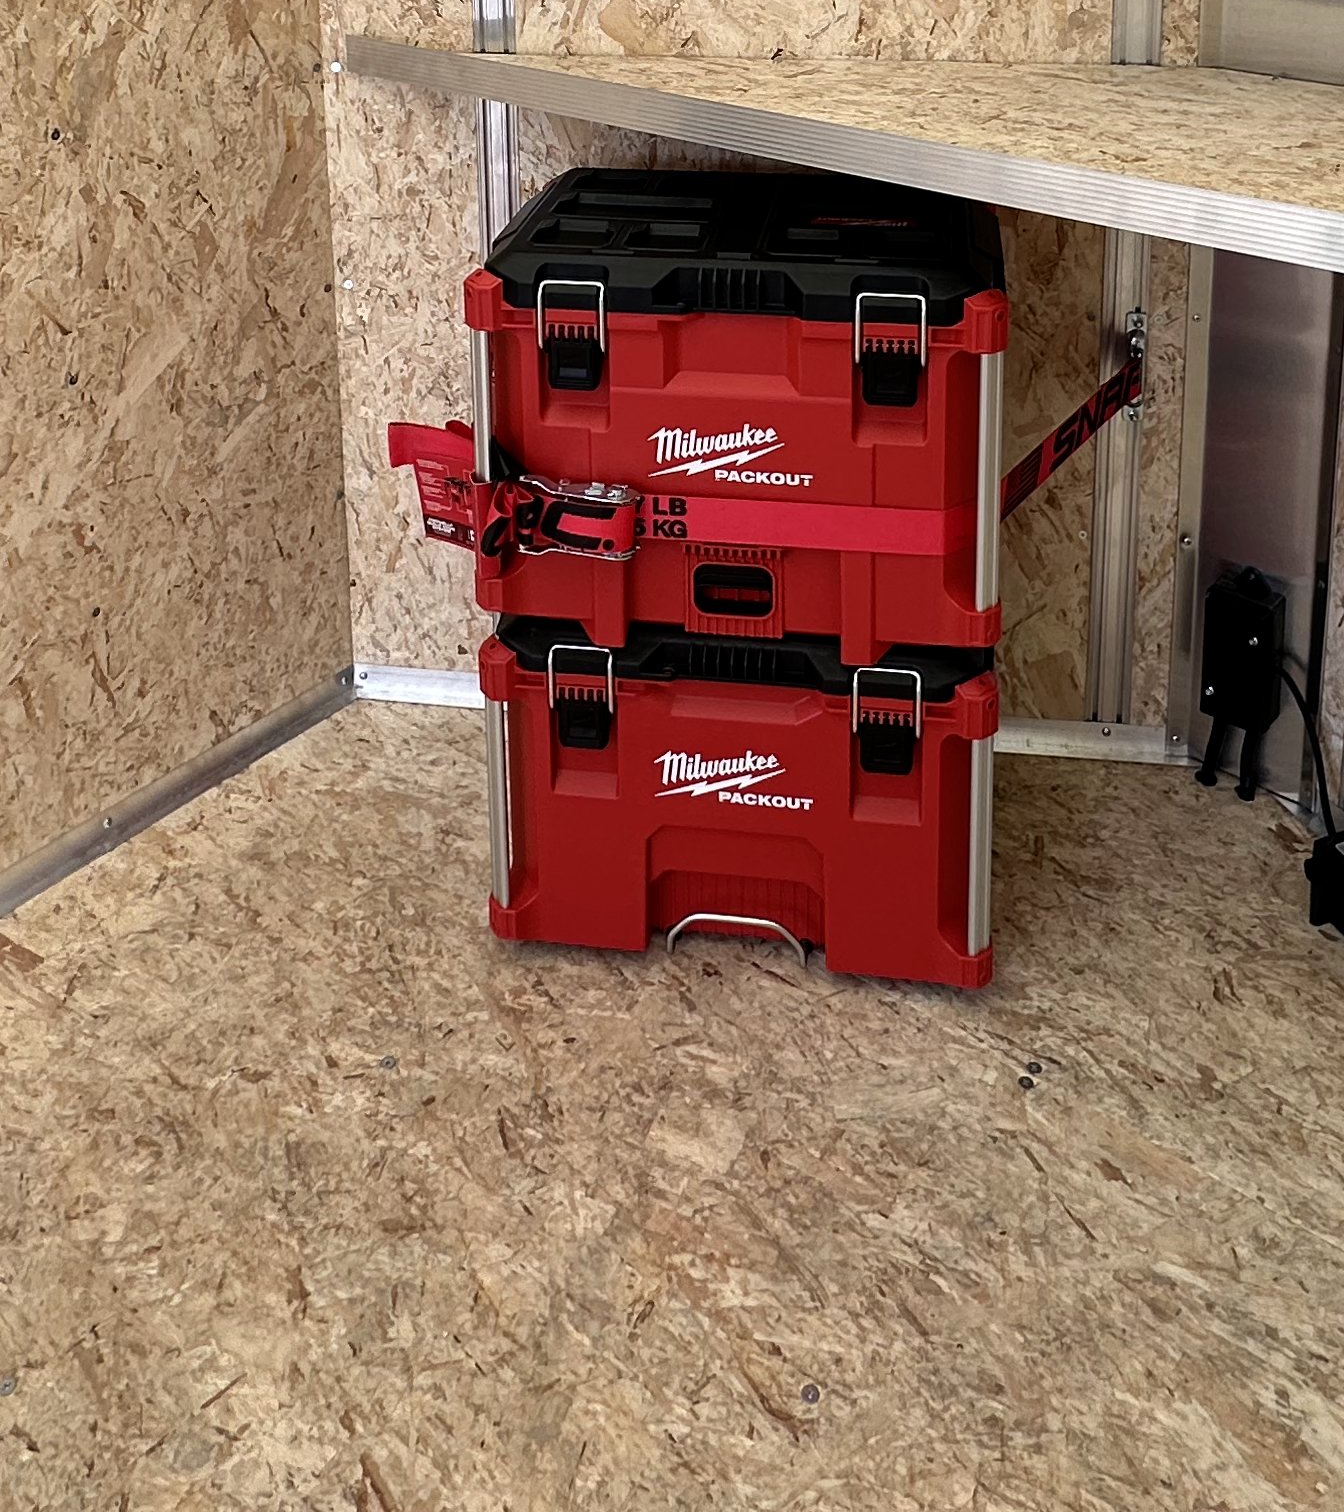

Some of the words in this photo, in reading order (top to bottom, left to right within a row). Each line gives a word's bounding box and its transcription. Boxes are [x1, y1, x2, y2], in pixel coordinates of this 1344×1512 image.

[647, 423, 779, 464] Milwaukee
[714, 469, 814, 487] PACKOUT
[652, 496, 688, 516] LB
[652, 519, 688, 538] KG
[653, 750, 780, 786] Milwaukee
[718, 791, 814, 811] PACKOUT
